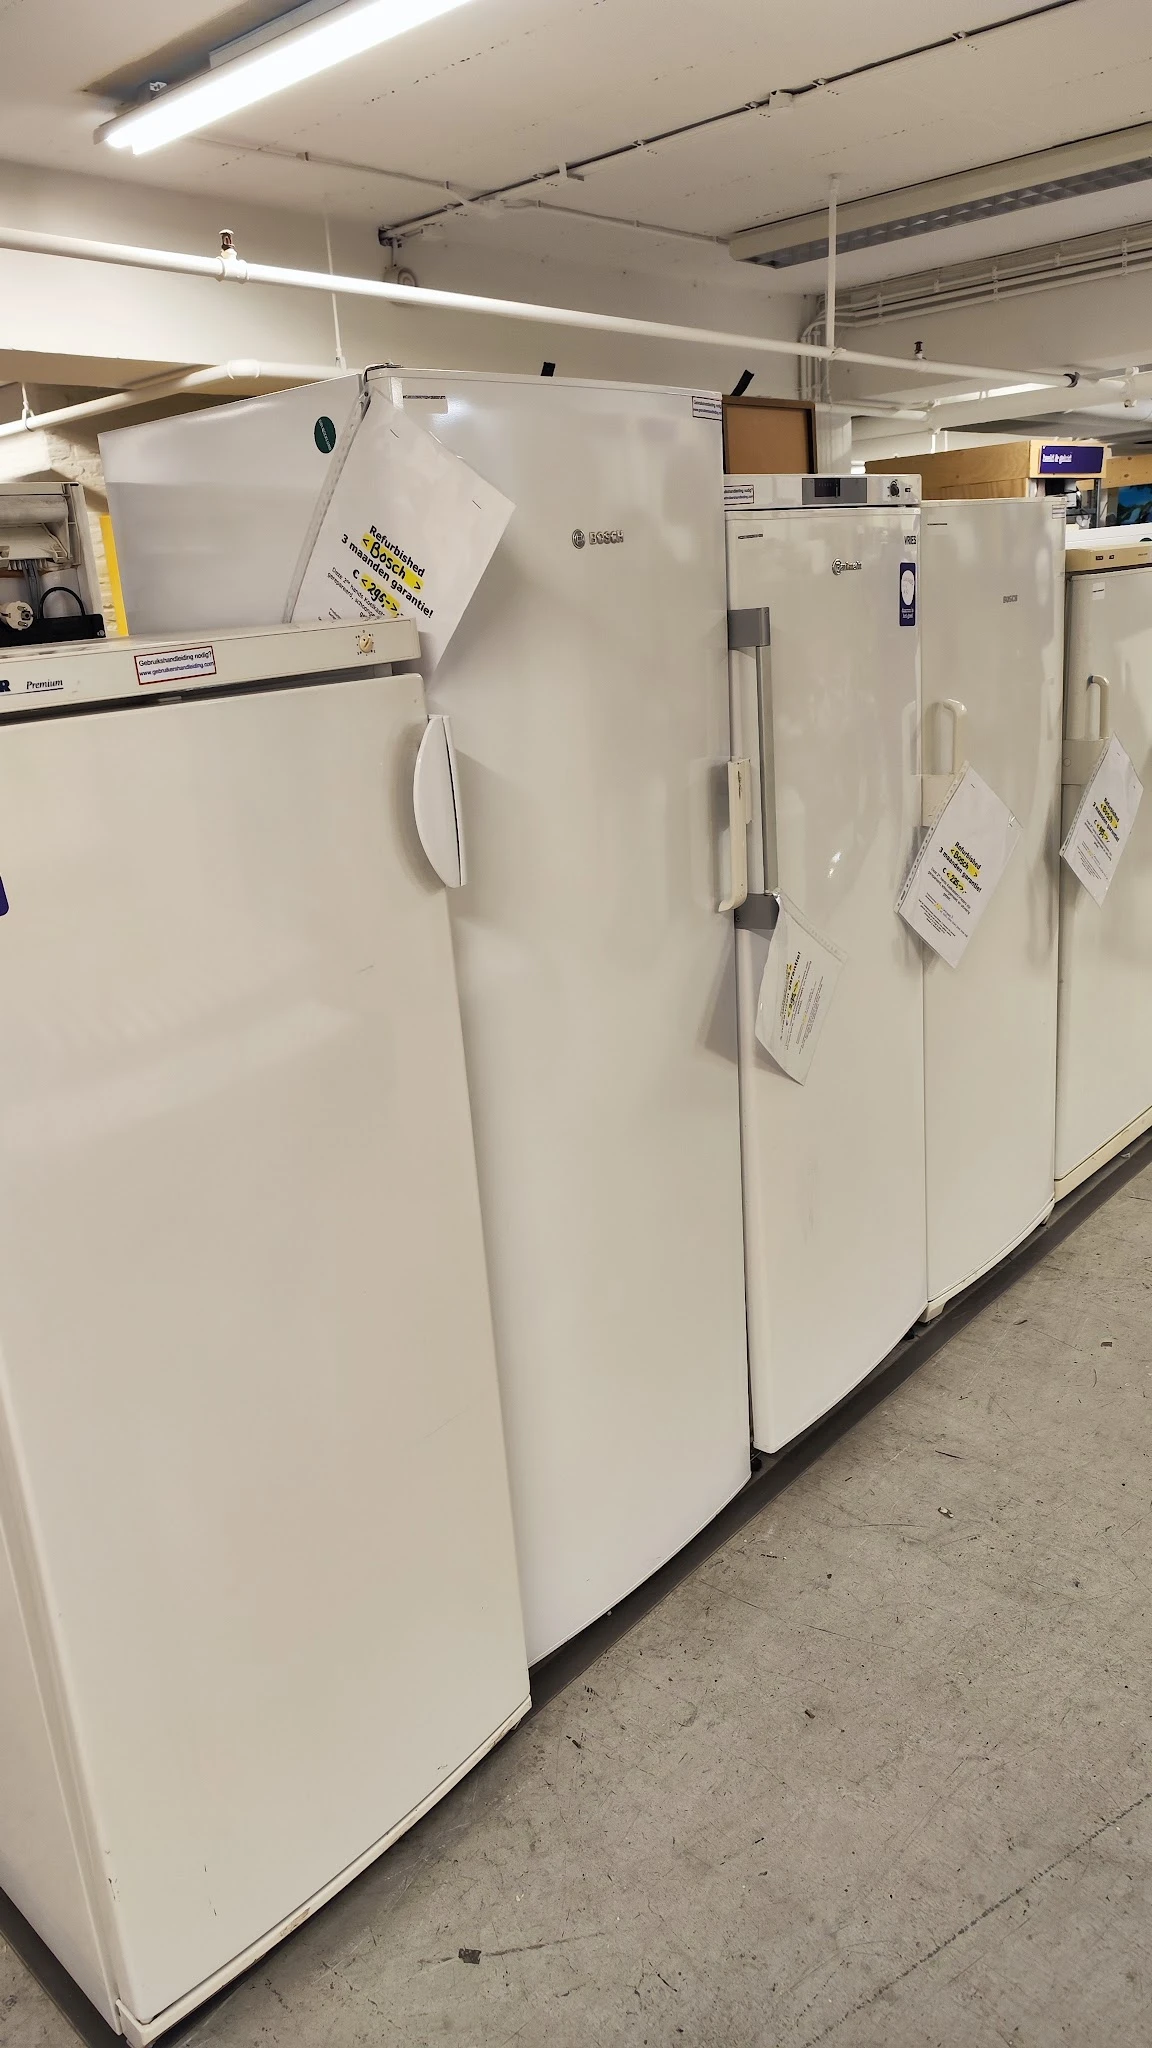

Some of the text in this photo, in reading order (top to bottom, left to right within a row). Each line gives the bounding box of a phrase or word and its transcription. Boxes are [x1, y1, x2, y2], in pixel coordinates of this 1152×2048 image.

[369, 525, 426, 578] Refurbished
[589, 531, 624, 545] BOSCH
[369, 541, 406, 580] Bosch
[341, 533, 349, 544] 3
[349, 542, 390, 582] maanden
[390, 579, 434, 619] garantie!
[138, 650, 212, 667] Gebruikshandleiding nodig?
[26, 679, 63, 690] Premium
